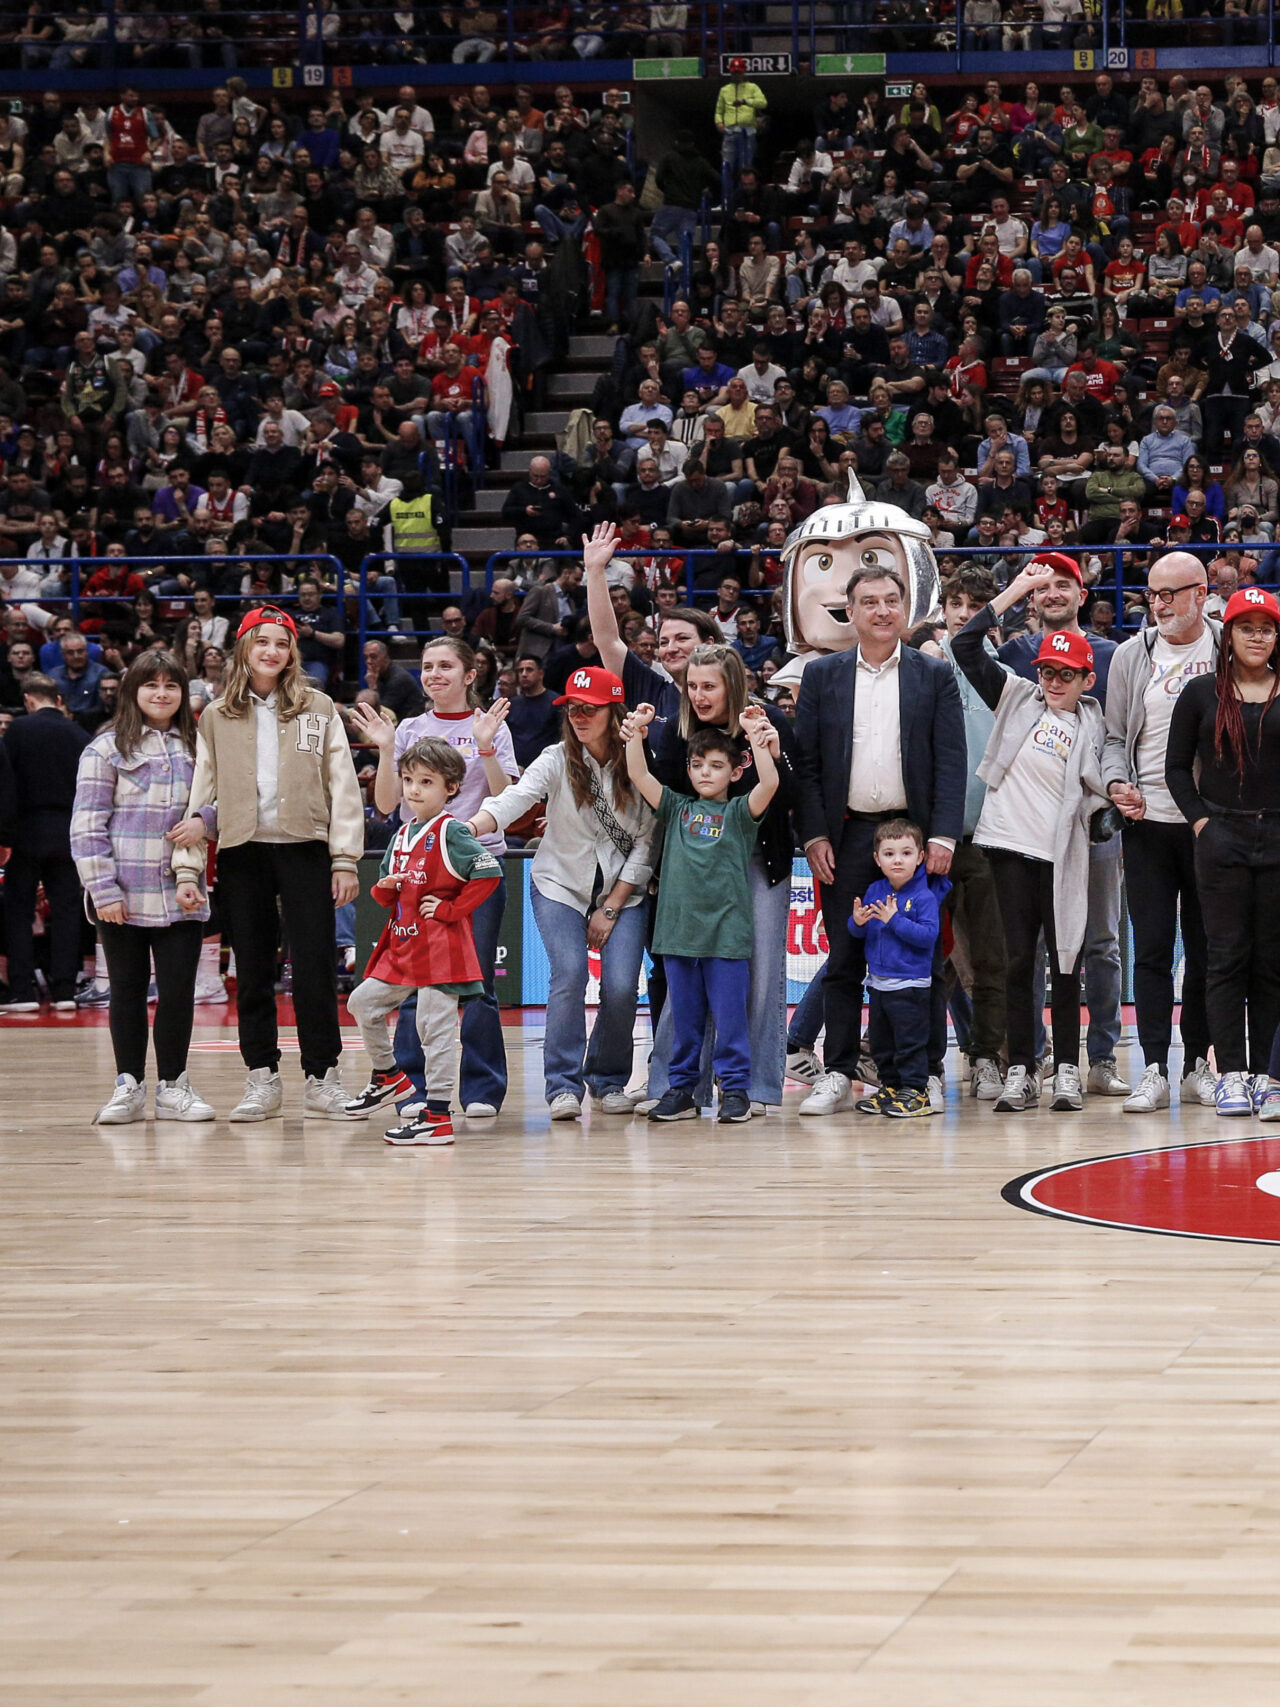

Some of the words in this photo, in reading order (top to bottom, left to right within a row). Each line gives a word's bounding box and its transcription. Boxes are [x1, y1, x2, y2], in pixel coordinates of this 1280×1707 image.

[1080, 52, 1088, 61] B
[1110, 52, 1126, 64] 20
[305, 69, 322, 82] 19
[296, 713, 329, 758] H
[1033, 729, 1070, 758] Cam
[688, 822, 723, 838] Cam
